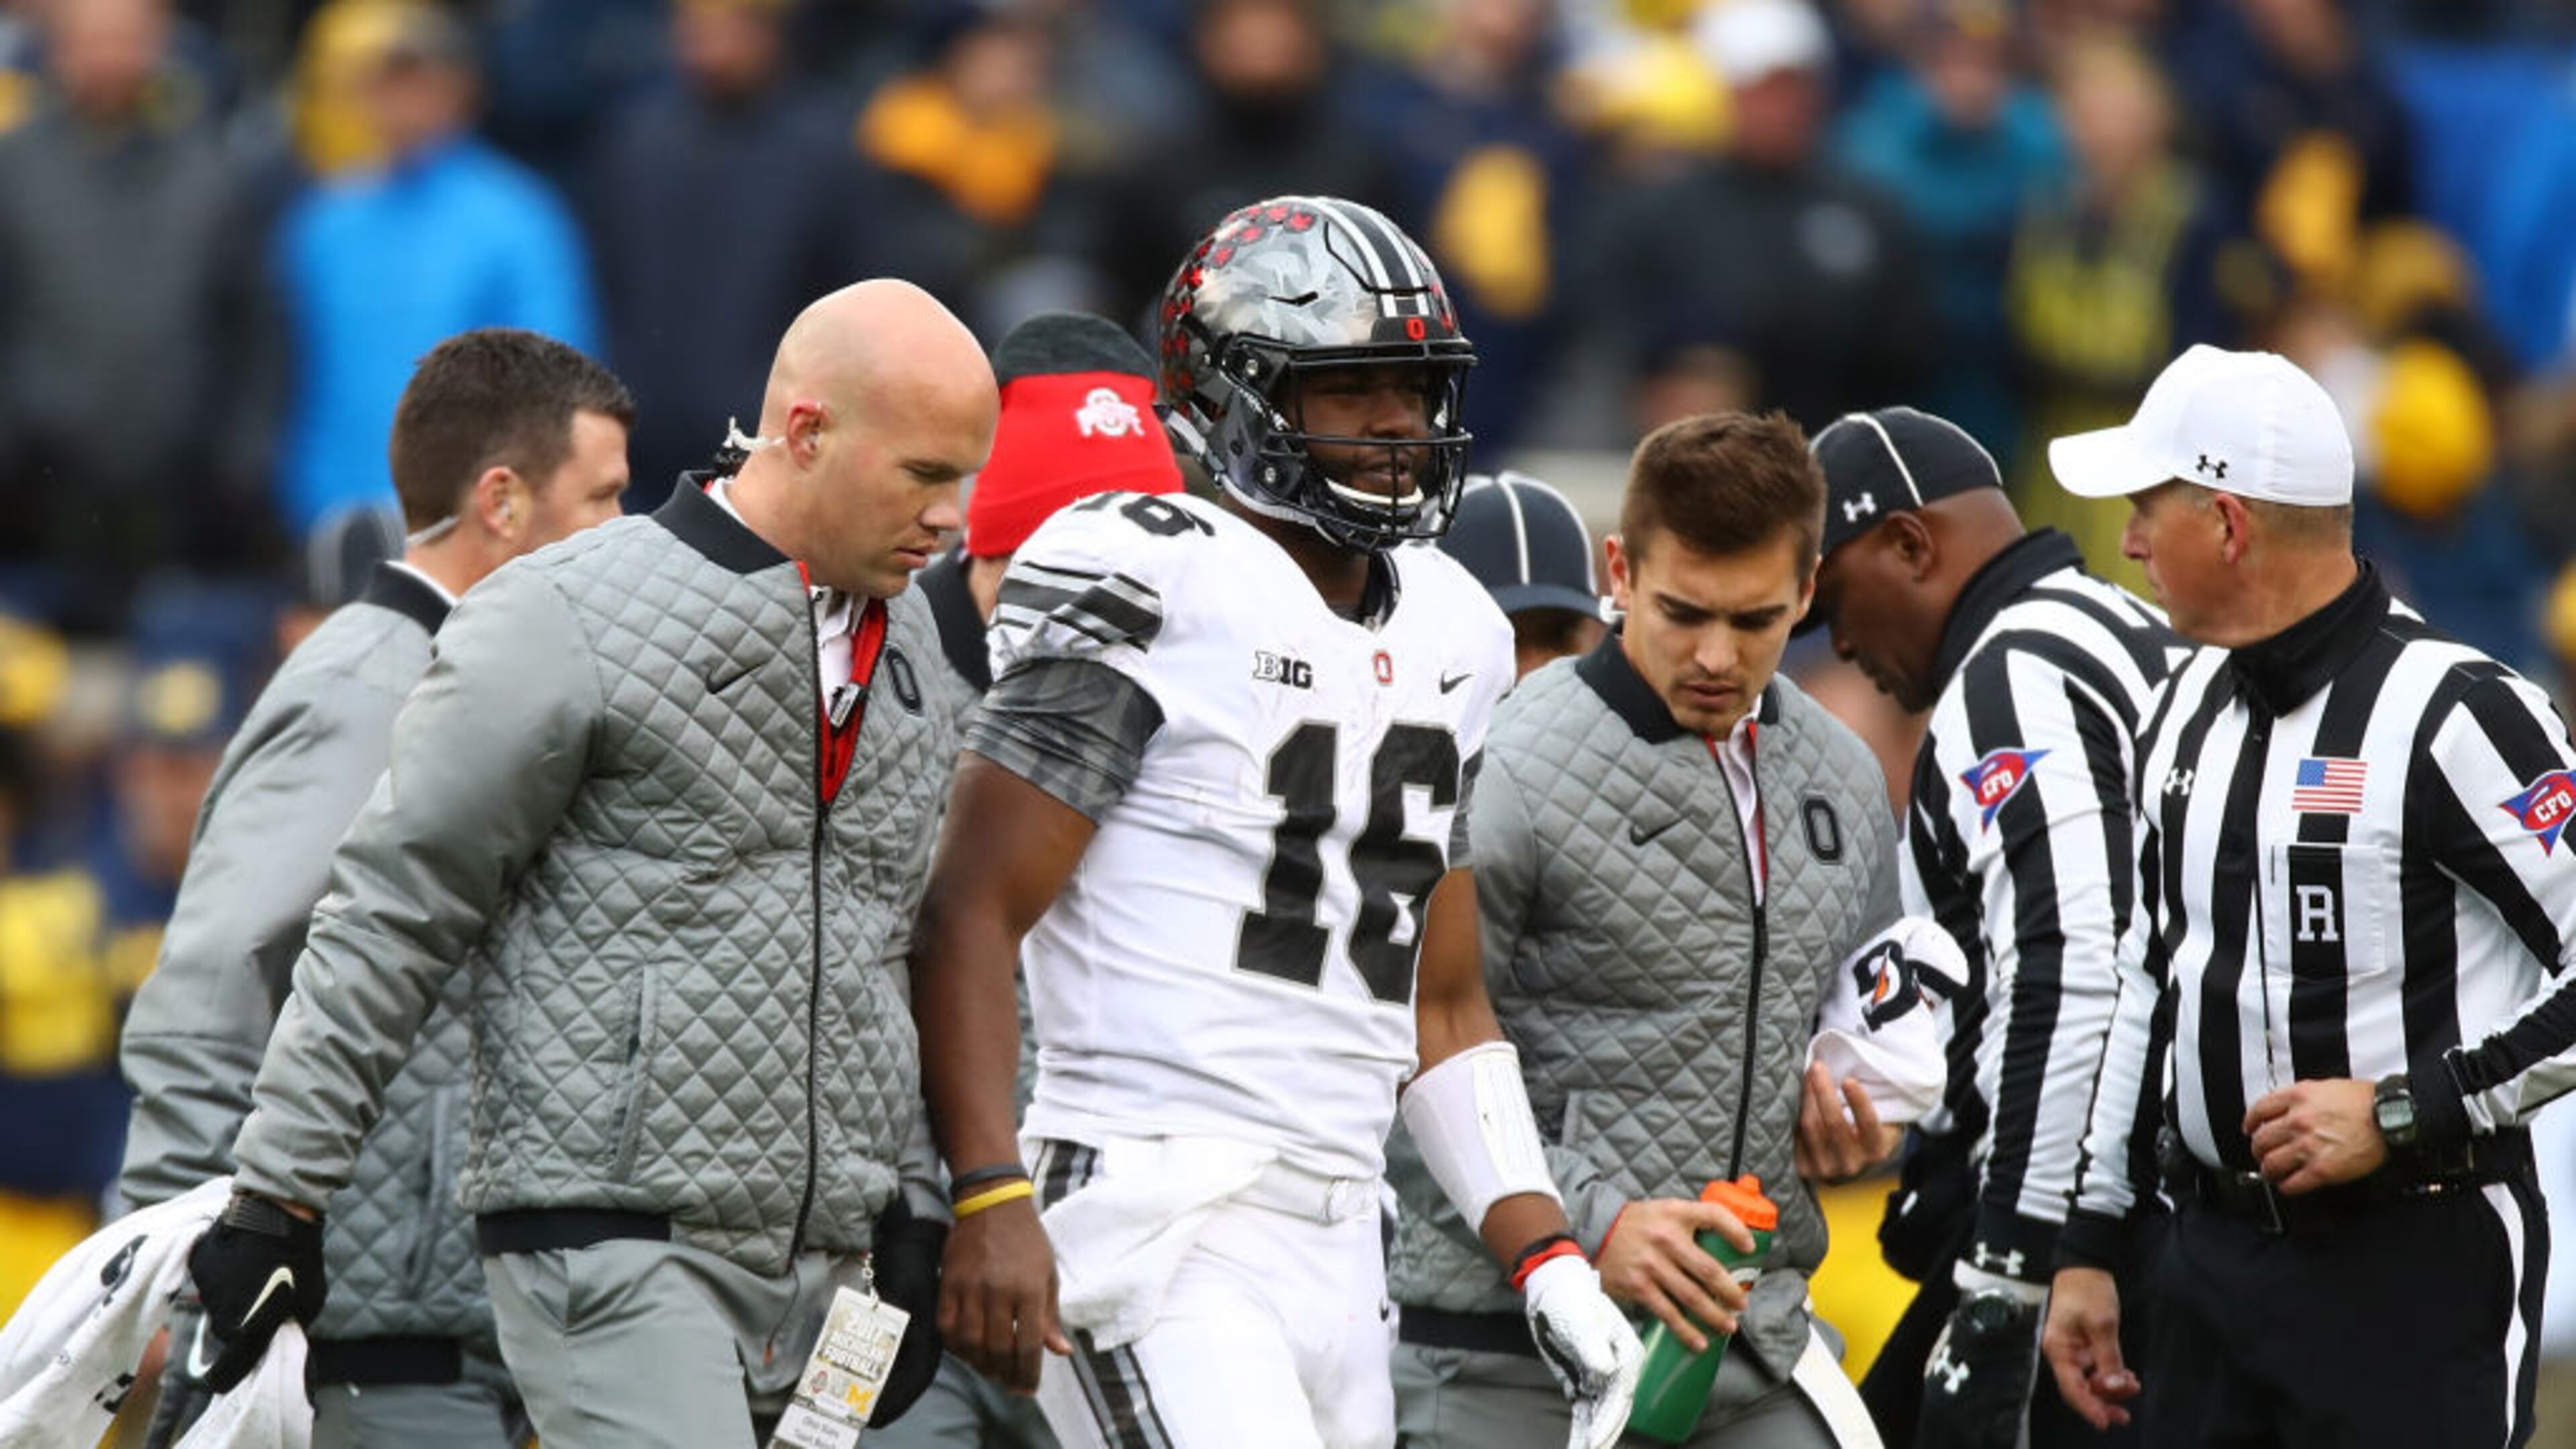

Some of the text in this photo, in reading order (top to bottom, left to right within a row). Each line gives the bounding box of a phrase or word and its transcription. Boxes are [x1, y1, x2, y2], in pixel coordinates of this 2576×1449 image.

[1982, 769, 2015, 800] CFO
[2534, 790, 2573, 822] CFO
[1231, 716, 1461, 1006] 16
[2296, 885, 2339, 942] R
